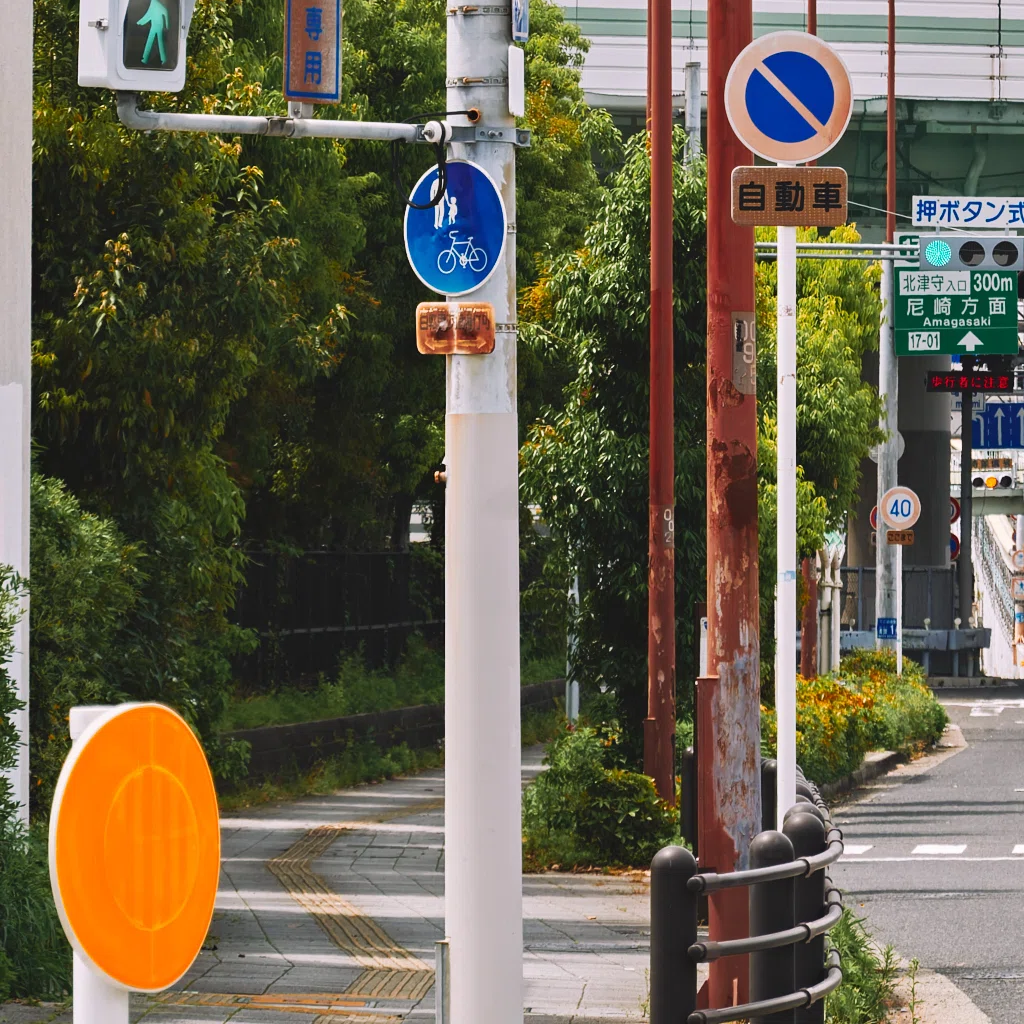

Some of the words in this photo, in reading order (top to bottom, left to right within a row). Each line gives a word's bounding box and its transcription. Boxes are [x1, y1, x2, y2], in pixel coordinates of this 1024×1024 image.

[303, 7, 323, 85] 専用
[739, 181, 842, 213] 自動車
[903, 275, 967, 292] 北津守入口
[973, 273, 1013, 292] 300m
[907, 297, 1006, 317] 尼崎方面
[923, 316, 991, 328] Amagasaki
[911, 333, 939, 349] 17-01
[932, 376, 1010, 389] 歩行者に注意
[890, 499, 911, 517] 40
